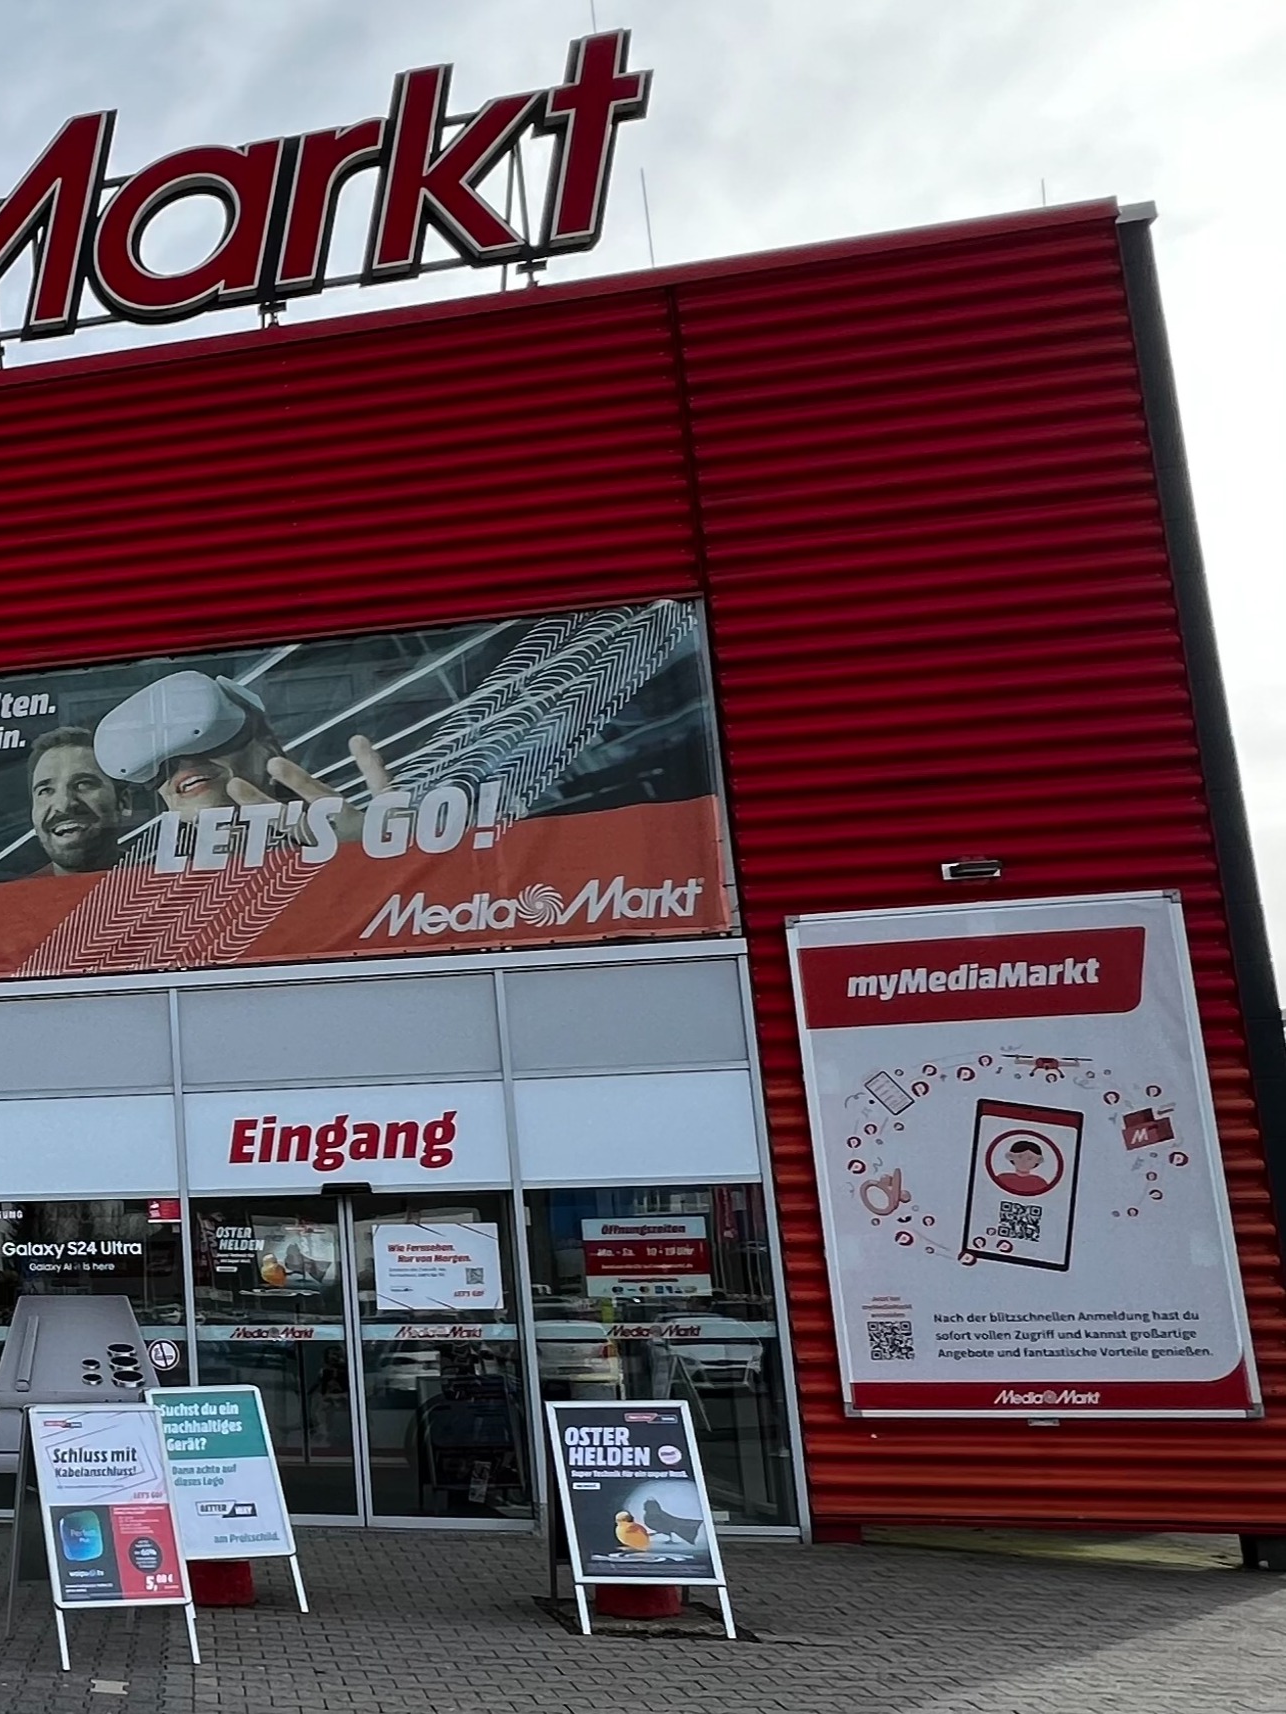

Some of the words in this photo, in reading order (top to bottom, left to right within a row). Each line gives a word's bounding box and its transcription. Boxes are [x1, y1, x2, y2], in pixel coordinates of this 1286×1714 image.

[154, 796, 345, 874] LET'S
[362, 781, 504, 859] GO!
[359, 892, 517, 940] Media
[558, 875, 703, 925] Markt
[846, 956, 1101, 1001] myMediaMarkt
[227, 1109, 458, 1173] Eingang
[216, 1226, 252, 1239] OSTER
[2, 1241, 64, 1259] Galaxy
[67, 1241, 98, 1255] S24
[100, 1240, 143, 1255] Ultra
[219, 1239, 265, 1251] HELDEN
[29, 1262, 62, 1273] Galaxy
[92, 1262, 115, 1271] here
[933, 1313, 964, 1323] Nach
[966, 1312, 986, 1323] der
[989, 1311, 1075, 1323] blitzschnellen
[1078, 1310, 1150, 1323] Anmeldung
[1152, 1310, 1180, 1321] hast
[1182, 1310, 1199, 1320] du
[935, 1330, 972, 1341] sofort
[974, 1330, 1012, 1340] vollen
[1014, 1329, 1055, 1343] Zugriff
[1057, 1329, 1082, 1339] und
[1084, 1329, 1128, 1339] kannst
[1130, 1328, 1197, 1341] großartige
[937, 1348, 994, 1361] Angebote
[997, 1348, 1020, 1358] und
[1023, 1347, 1097, 1358] fantastische
[1099, 1346, 1149, 1357] Vorteile
[1151, 1346, 1214, 1359] genießen.
[160, 1403, 199, 1417] Suchst
[201, 1403, 218, 1416] du
[219, 1402, 239, 1415] ein
[164, 1419, 242, 1434] nachhaltiges
[166, 1436, 207, 1451] Gerät?
[564, 1426, 631, 1447] OSTER
[53, 1448, 108, 1464] Schluss
[110, 1446, 138, 1462] mit
[568, 1446, 652, 1467] HELDEN
[55, 1465, 137, 1478] Kabelanschluss!
[172, 1466, 194, 1475] Dann
[196, 1465, 220, 1475] achte
[222, 1464, 237, 1473] auf
[174, 1477, 201, 1486] dieses
[203, 1477, 224, 1487] Logo
